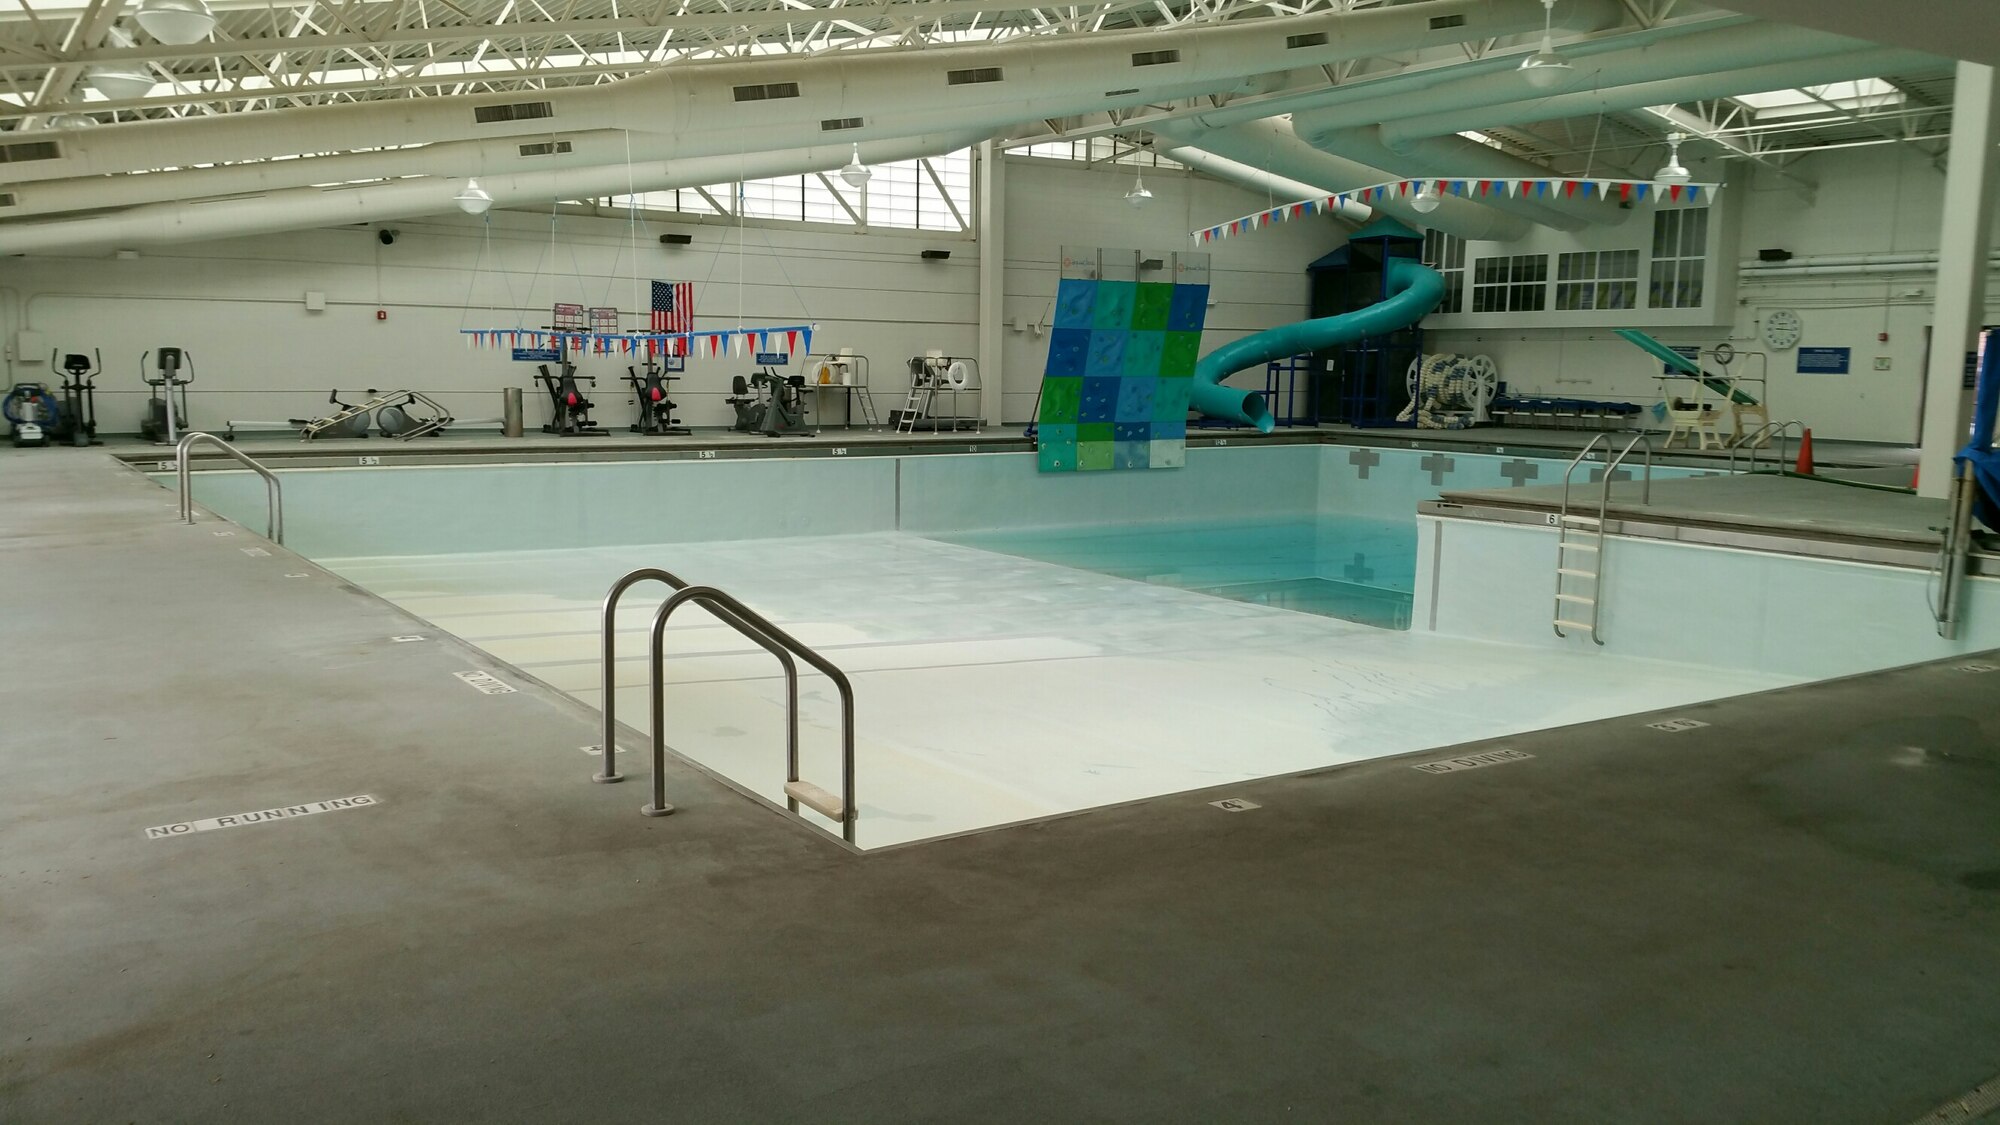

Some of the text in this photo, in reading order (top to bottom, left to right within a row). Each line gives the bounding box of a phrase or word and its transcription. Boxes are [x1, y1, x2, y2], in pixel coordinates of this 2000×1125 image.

[1549, 514, 1555, 524] 6
[1417, 750, 1528, 774] NO DIVING
[150, 823, 190, 838] NO
